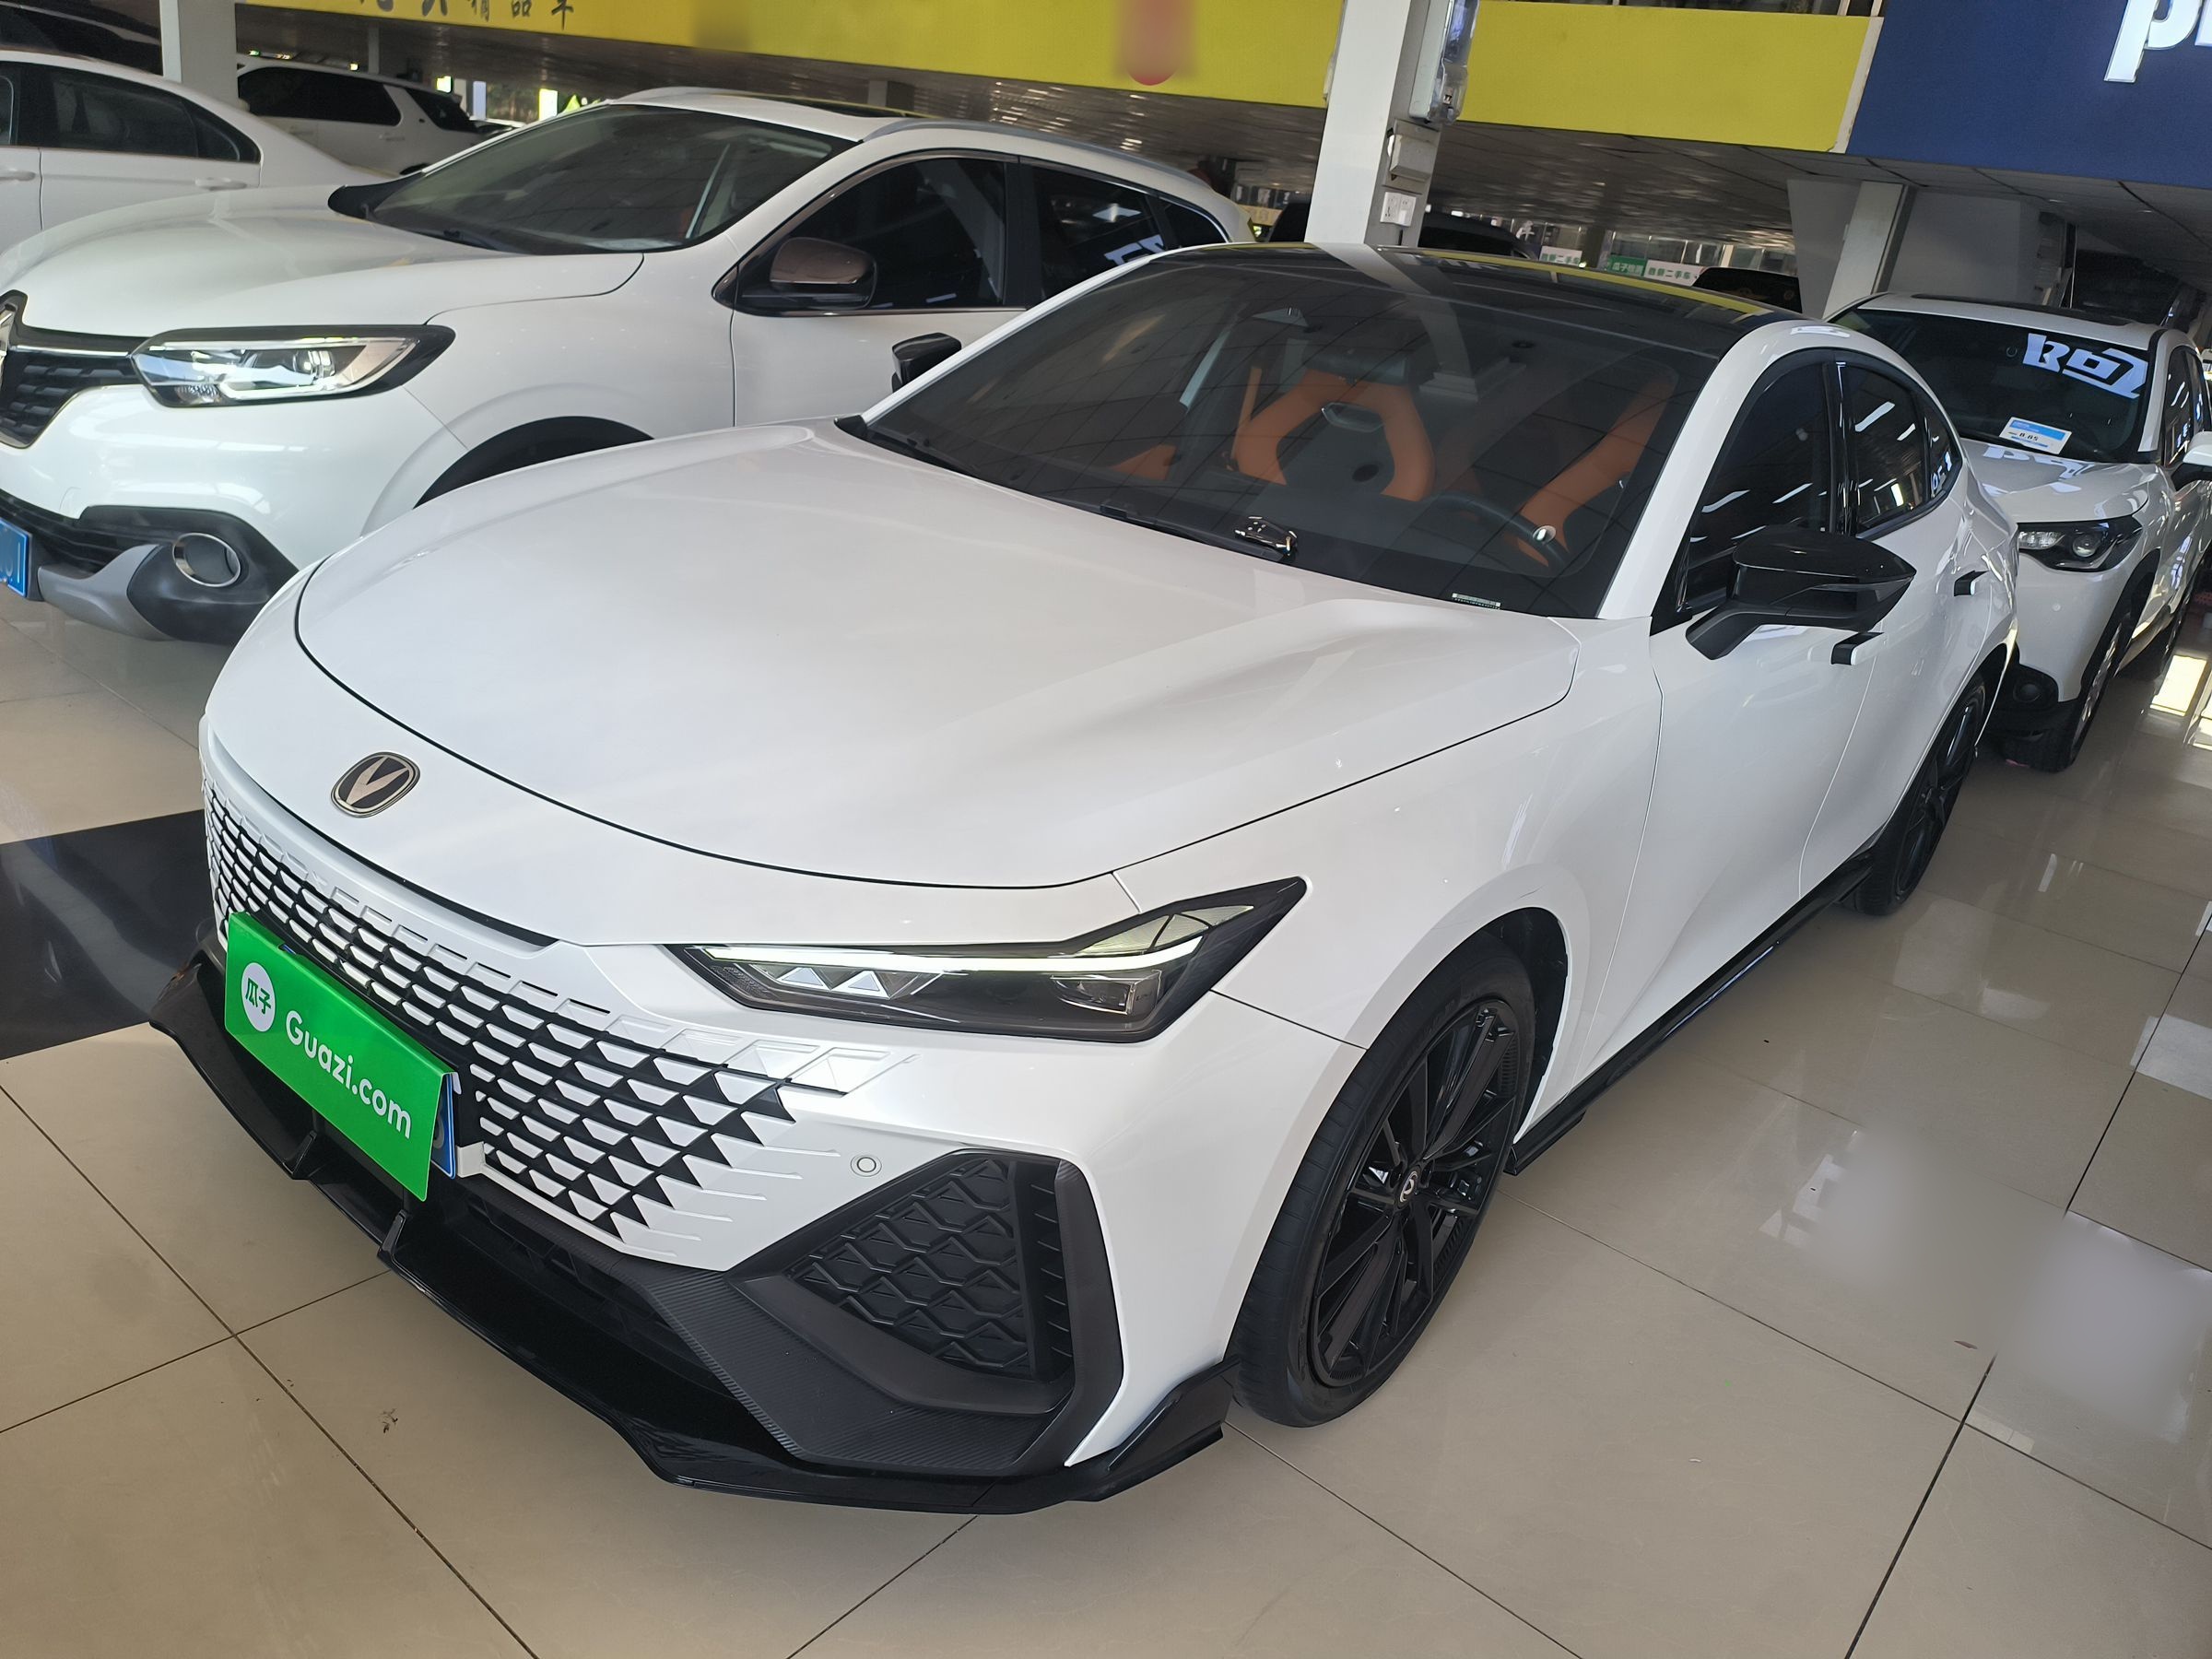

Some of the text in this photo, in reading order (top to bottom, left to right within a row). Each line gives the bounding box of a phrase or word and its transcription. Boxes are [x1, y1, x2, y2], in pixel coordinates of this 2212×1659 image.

[2103, 0, 2212, 83] p
[244, 977, 272, 1015] 瓜子
[286, 1010, 412, 1139] Guazi.com
